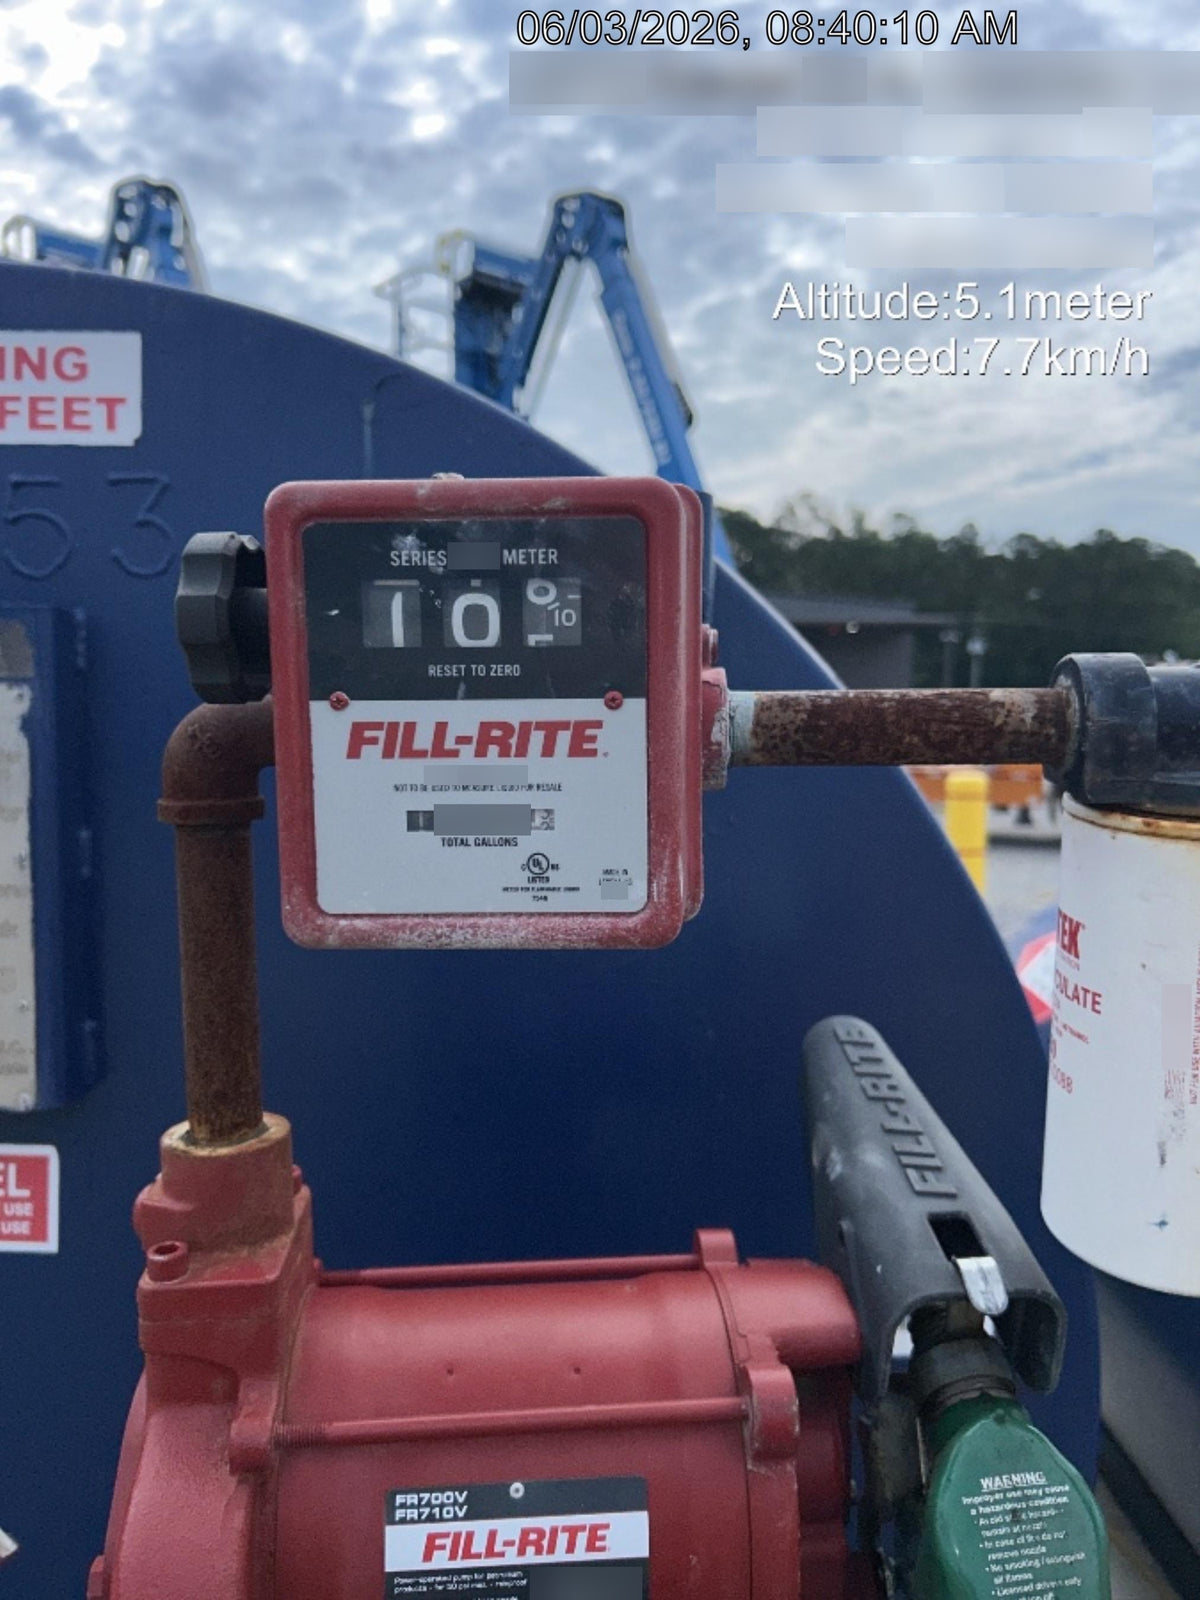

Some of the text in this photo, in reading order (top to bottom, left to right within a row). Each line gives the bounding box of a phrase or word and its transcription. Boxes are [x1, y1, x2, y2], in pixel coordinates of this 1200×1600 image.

[0, 396, 127, 431] FEET
[390, 549, 559, 567] SERIES METER
[428, 664, 521, 678] RESET TO ZERO
[346, 719, 604, 760] FILL-RITE
[440, 836, 518, 847] TOTAL GALLONS
[3, 1202, 34, 1217] USE
[0, 1220, 31, 1235] USE
[980, 1472, 1047, 1490] WARNING
[395, 1491, 468, 1506] FR700V
[395, 1506, 468, 1521] FR710V
[421, 1523, 610, 1563] FILL-RITE
